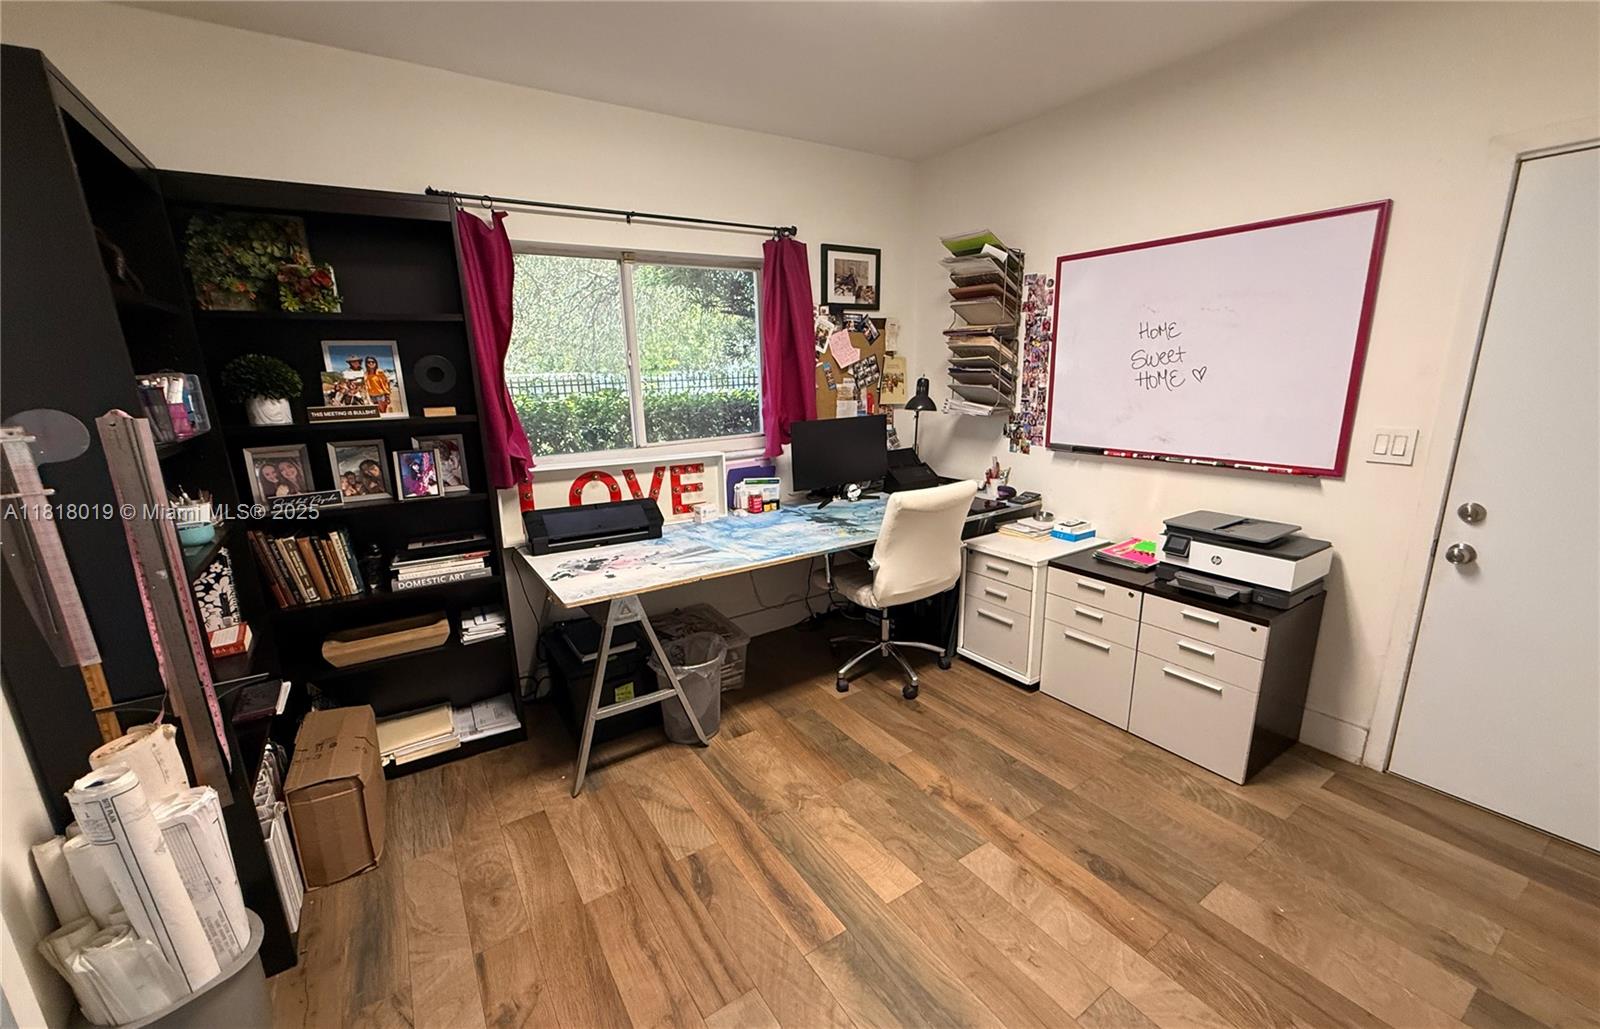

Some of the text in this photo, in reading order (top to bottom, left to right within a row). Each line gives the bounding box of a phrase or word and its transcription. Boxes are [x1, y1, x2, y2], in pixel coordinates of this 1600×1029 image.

[1139, 321, 1182, 340] HOME
[1130, 346, 1187, 370] Sweet
[1135, 369, 1186, 391] HOME
[398, 575, 447, 590] DOMESTIC
[448, 572, 466, 582] ART
